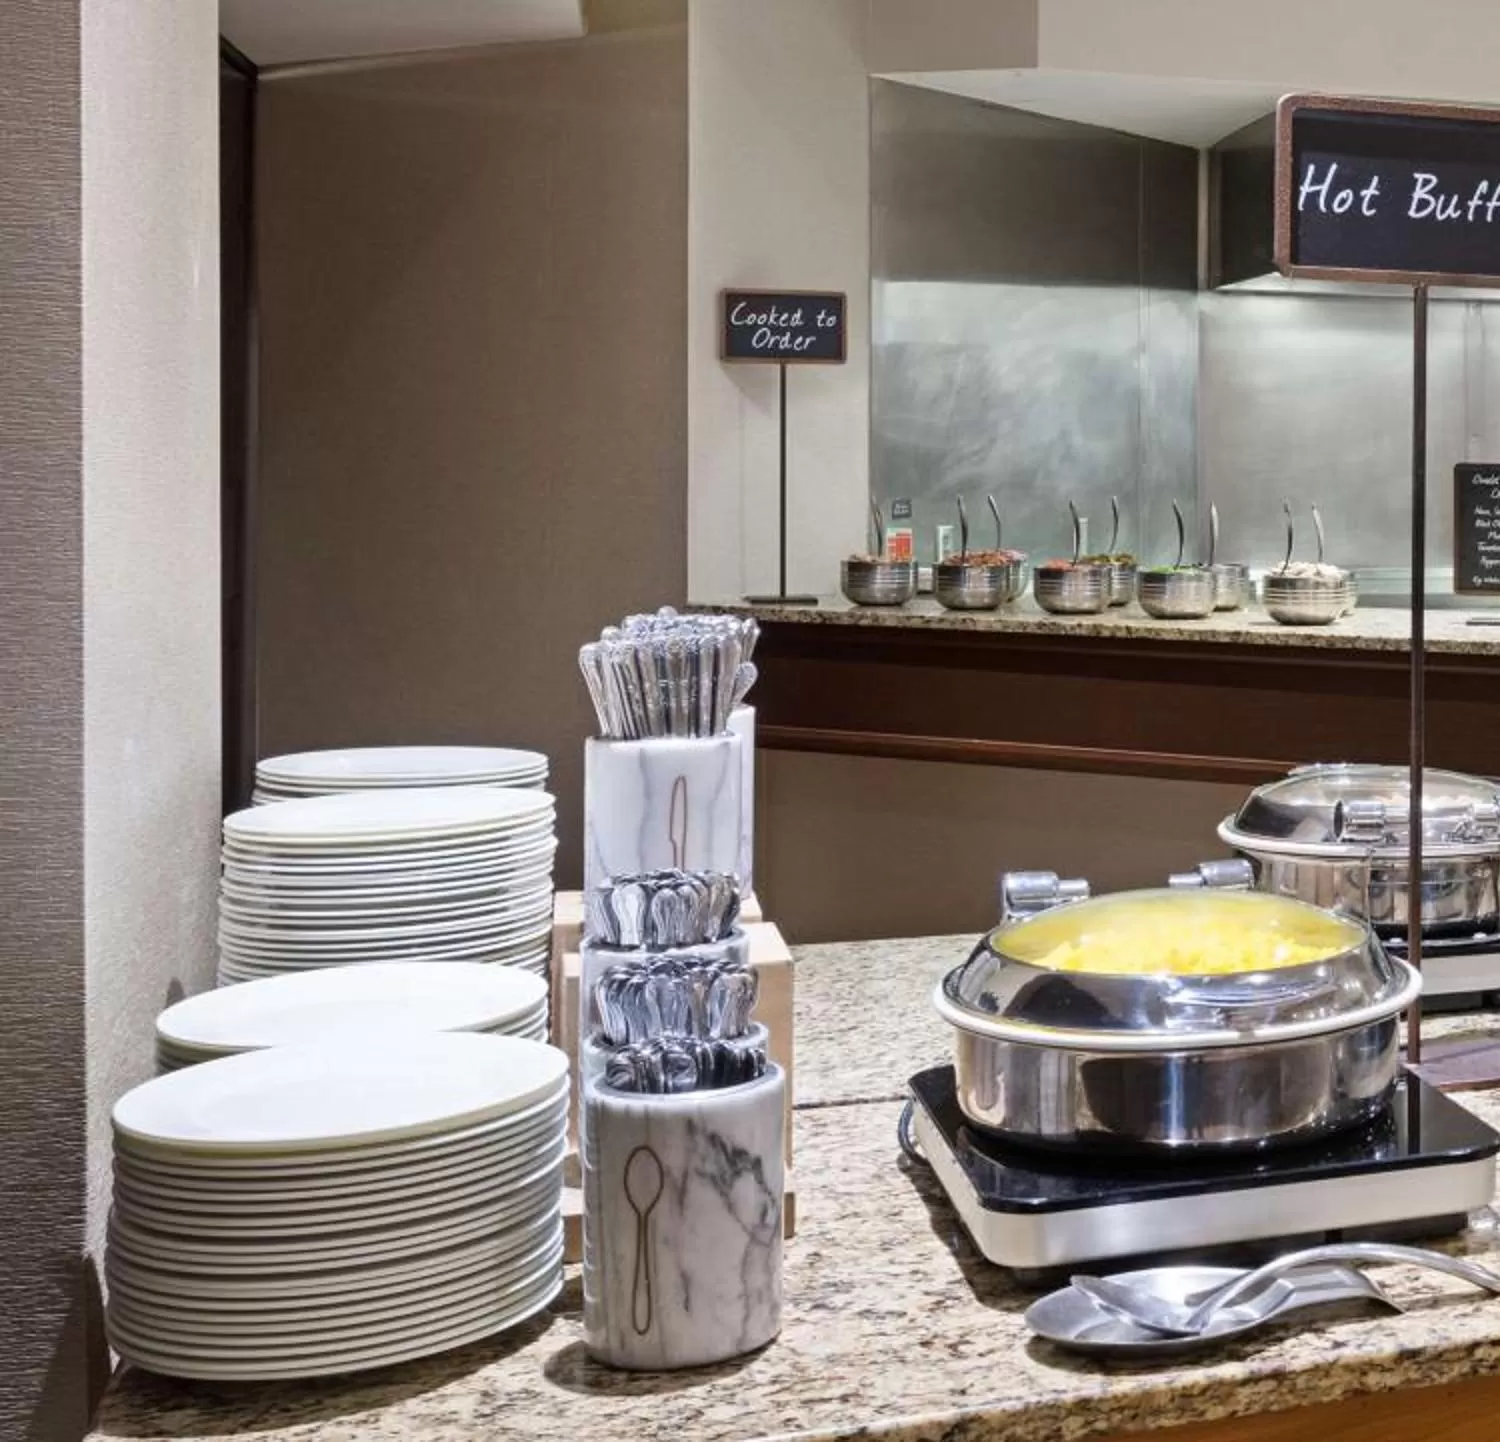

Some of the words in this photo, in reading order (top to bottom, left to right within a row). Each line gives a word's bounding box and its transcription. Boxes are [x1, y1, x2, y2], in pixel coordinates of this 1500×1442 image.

[1297, 162, 1380, 217] Hot
[731, 301, 804, 327] Cooked
[816, 308, 837, 327] to
[751, 327, 816, 351] Order
